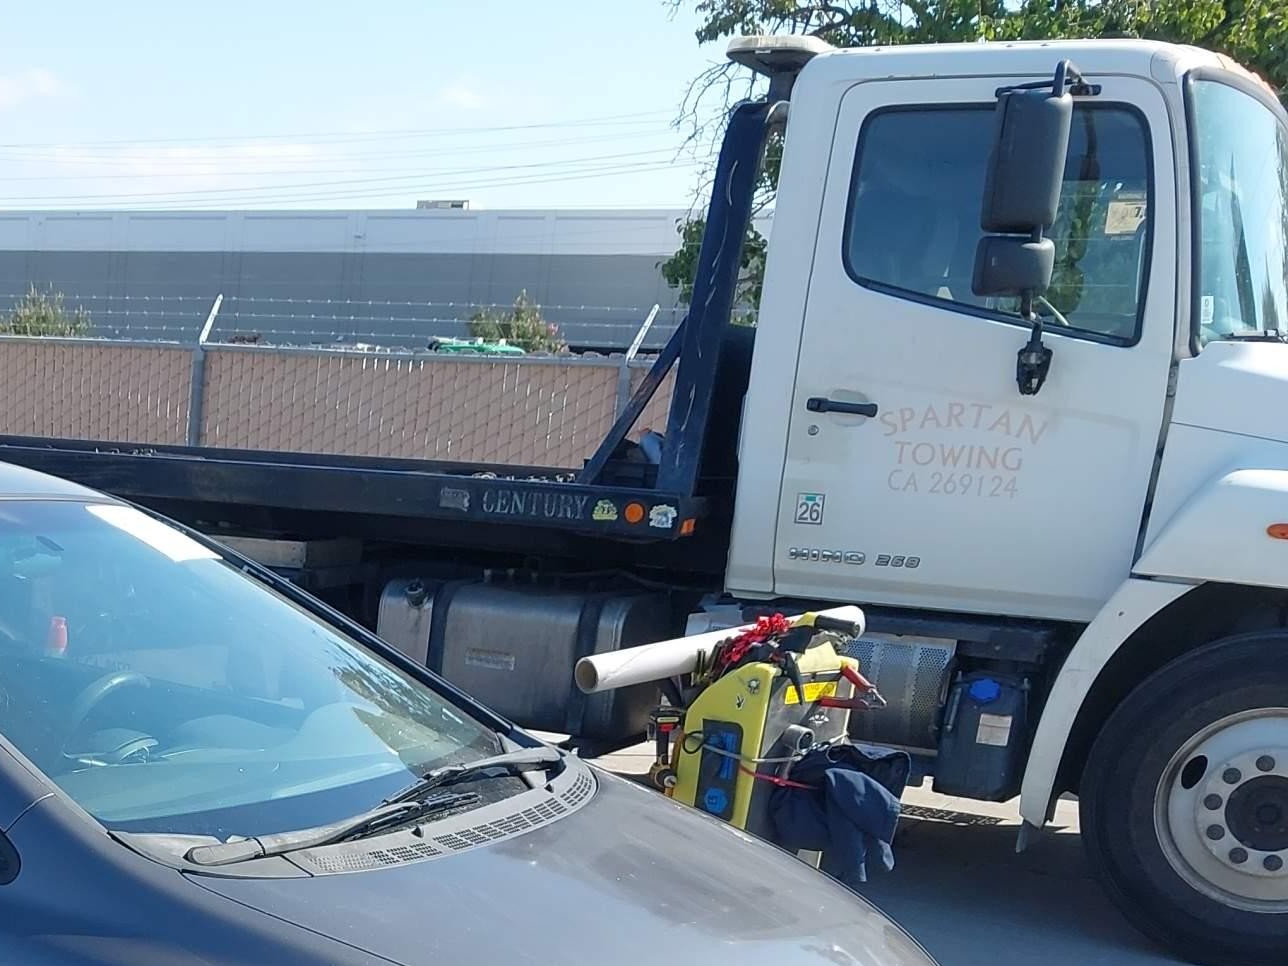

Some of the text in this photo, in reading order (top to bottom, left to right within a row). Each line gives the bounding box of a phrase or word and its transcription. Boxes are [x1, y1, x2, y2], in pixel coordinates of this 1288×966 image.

[879, 402, 1049, 445] SPARTAN
[895, 440, 1023, 471] TOWING
[887, 469, 1019, 499] CA 269124
[482, 489, 589, 520] CENTURY
[797, 501, 821, 522] 26
[788, 547, 921, 569] HINO 268
